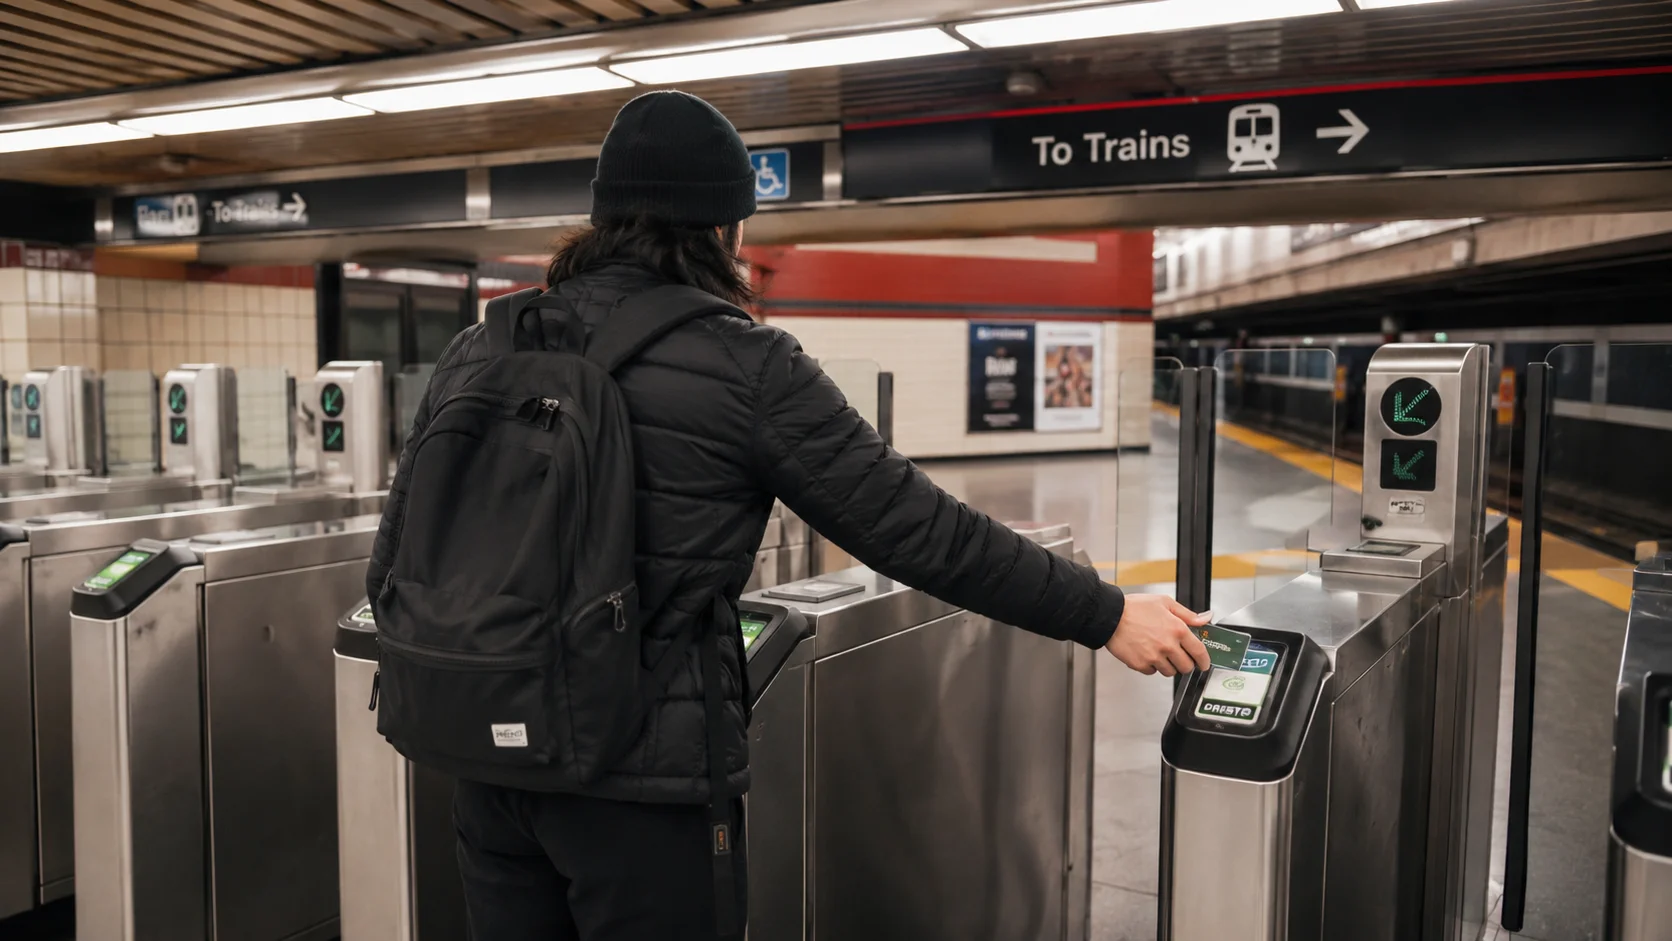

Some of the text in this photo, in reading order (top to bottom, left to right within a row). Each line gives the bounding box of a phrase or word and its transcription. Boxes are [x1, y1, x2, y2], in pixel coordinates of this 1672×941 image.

[1032, 129, 1191, 166] To Trains
[211, 200, 231, 223] To
